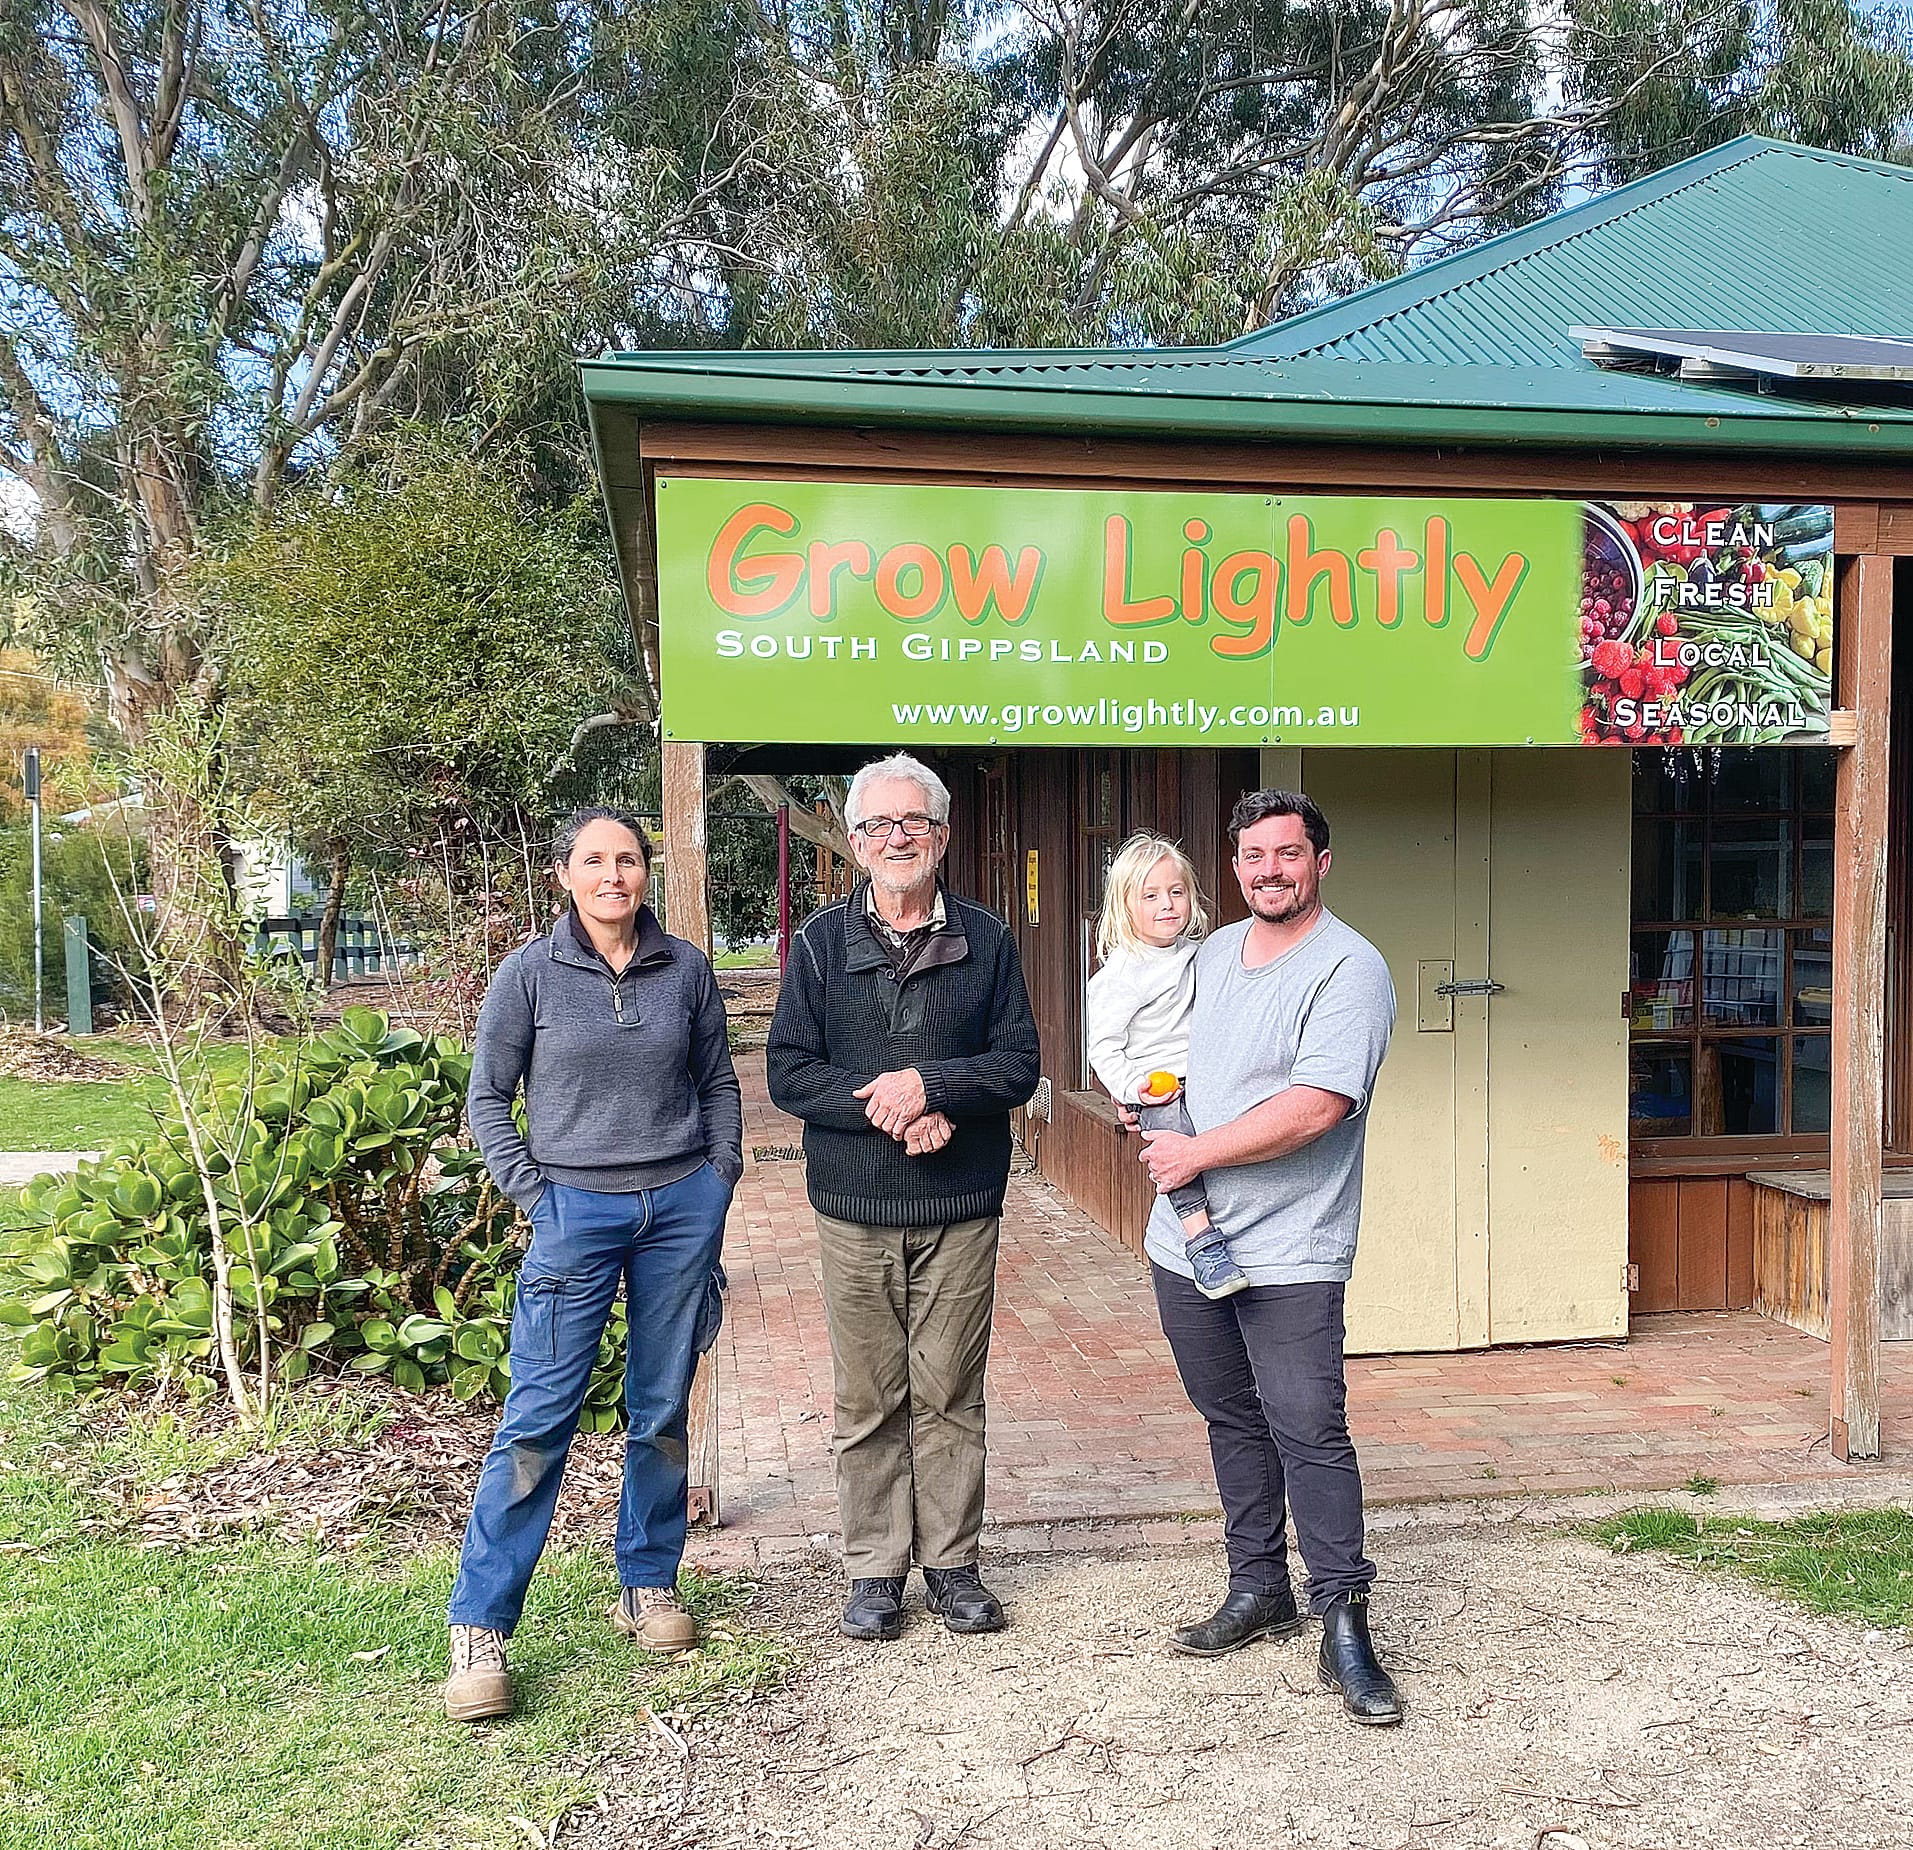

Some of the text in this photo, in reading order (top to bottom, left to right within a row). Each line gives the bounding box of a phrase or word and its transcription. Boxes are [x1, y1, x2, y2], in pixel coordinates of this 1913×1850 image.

[1653, 517, 1775, 547] CLEAN
[707, 503, 1531, 663] Grow Lightly
[1653, 577, 1774, 607] FRESH
[715, 629, 1170, 664] SOUTH GIPPSLAND
[1653, 637, 1771, 668] LOCAL
[892, 698, 1360, 733] www.growlightly.com.au
[1614, 698, 1807, 728] SEASONAL
